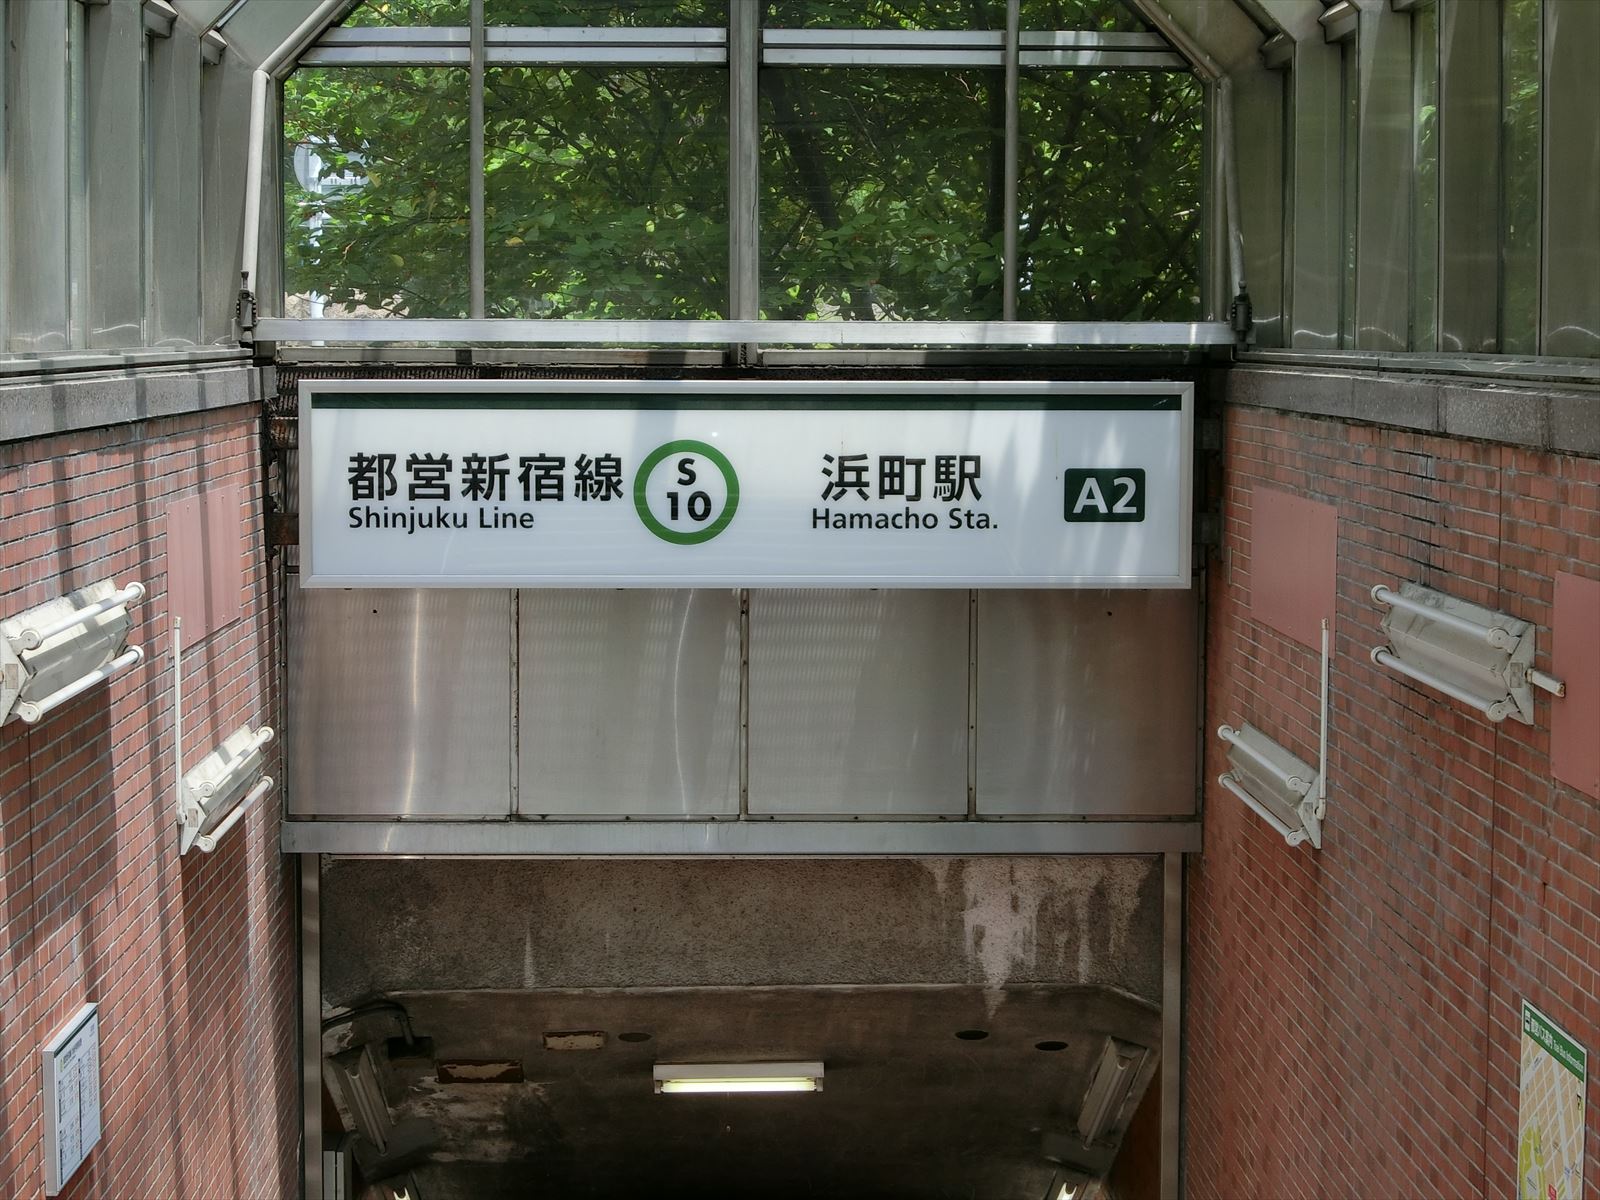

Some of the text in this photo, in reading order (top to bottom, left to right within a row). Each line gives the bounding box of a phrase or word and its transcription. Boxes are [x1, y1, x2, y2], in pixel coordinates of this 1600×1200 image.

[347, 452, 624, 502] 都営新宿線
[677, 457, 697, 486] S
[820, 453, 983, 502] 浜町駅
[666, 490, 712, 522] 10
[1072, 476, 1138, 514] A2
[348, 506, 535, 535] Shinjuku Line
[812, 506, 998, 530] Hamacho Sta.
